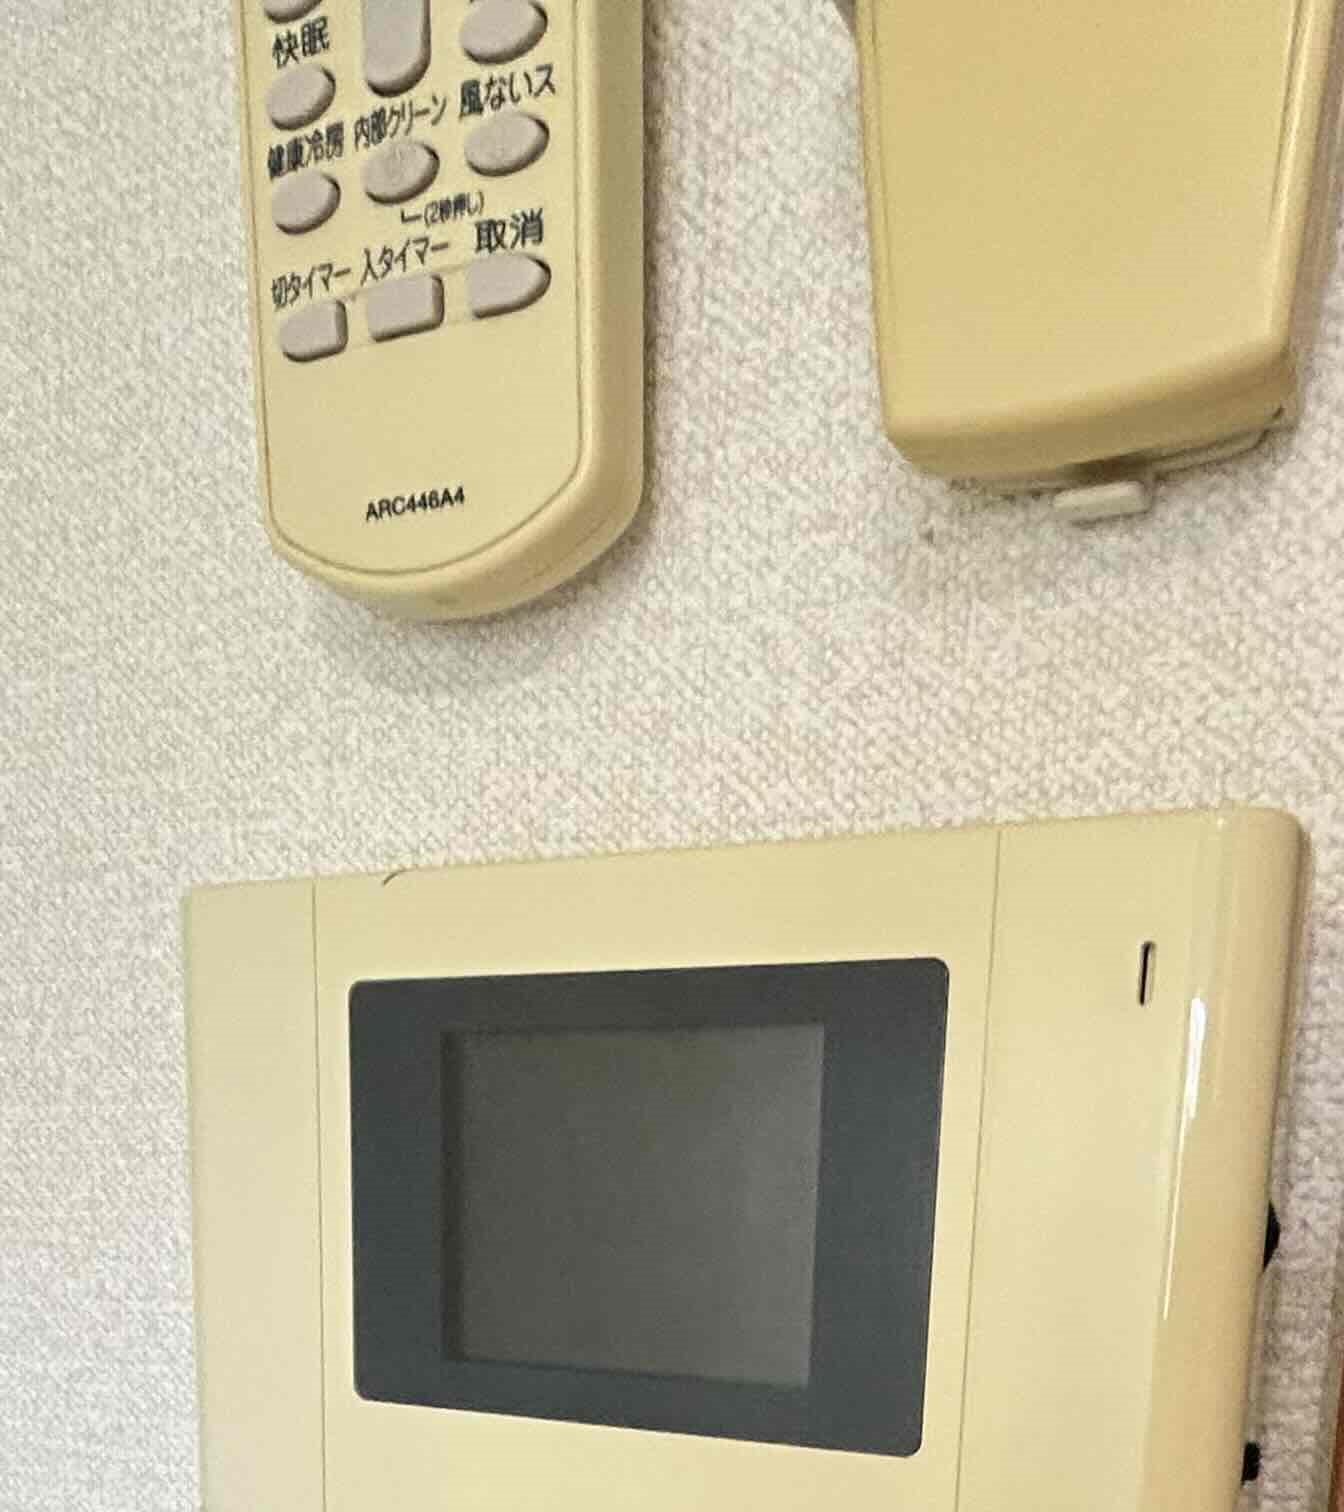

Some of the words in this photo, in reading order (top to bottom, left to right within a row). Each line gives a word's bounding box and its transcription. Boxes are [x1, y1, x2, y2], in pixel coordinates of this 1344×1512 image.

[272, 16, 330, 69] 快眠
[474, 207, 544, 253] 取消
[360, 236, 449, 287] 入タイマー
[271, 263, 351, 311] 切タイマー
